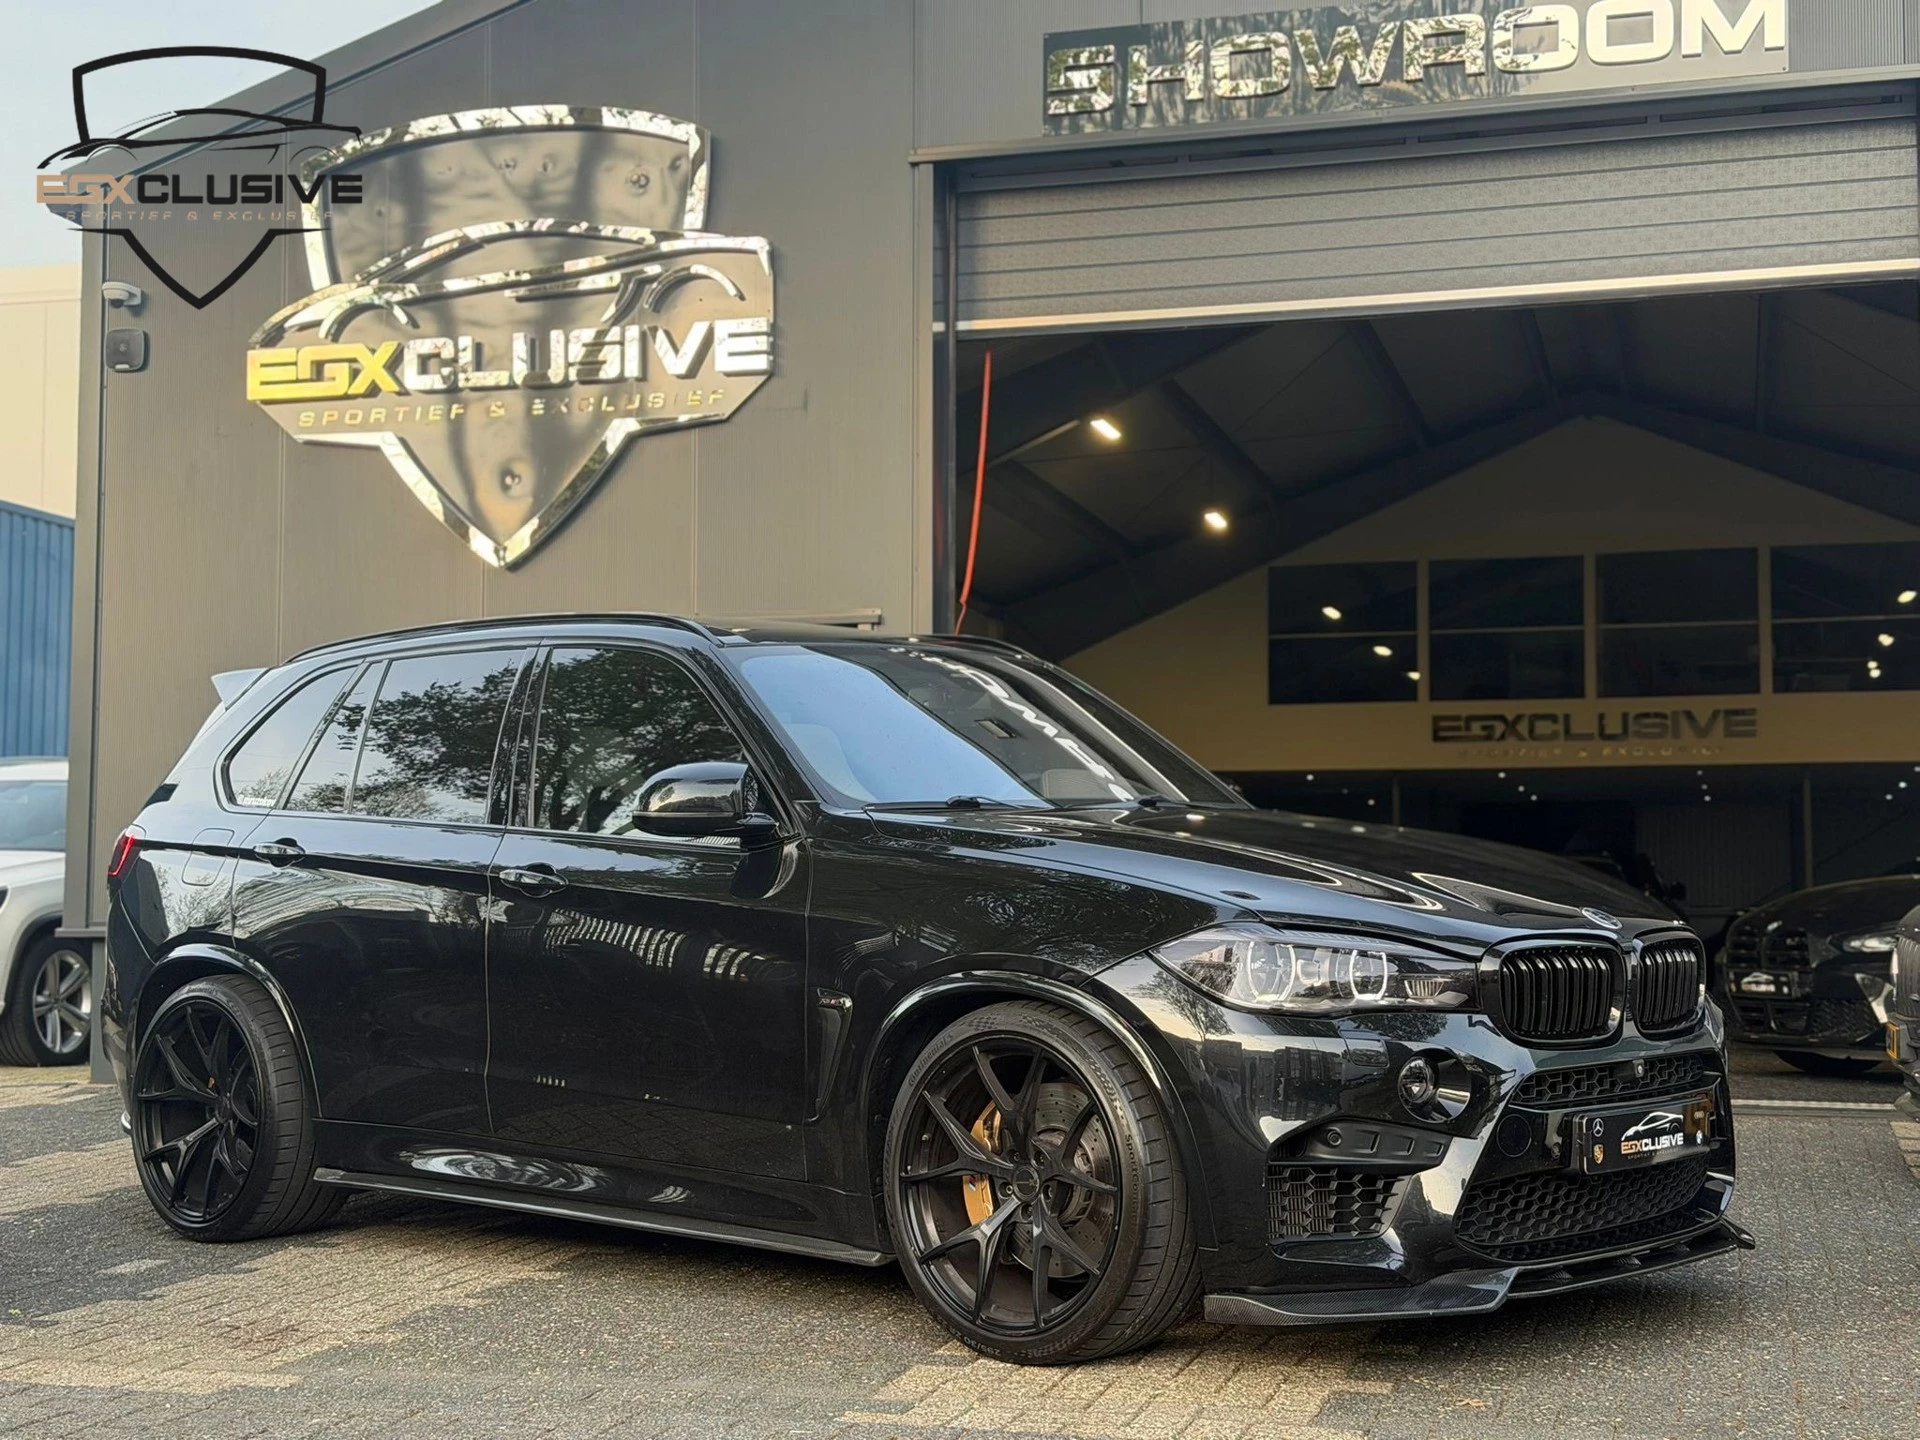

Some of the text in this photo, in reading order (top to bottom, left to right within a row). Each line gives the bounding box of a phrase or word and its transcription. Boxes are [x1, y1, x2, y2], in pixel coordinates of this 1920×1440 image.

[1048, 0, 1785, 116] SHOWROOM
[247, 317, 773, 400] EGXCLUSIVE
[298, 403, 465, 427] SPORTIEF
[1432, 708, 1757, 742] EGXCLUSIVE
[1621, 1133, 1684, 1154] EGXCLUSIVE
